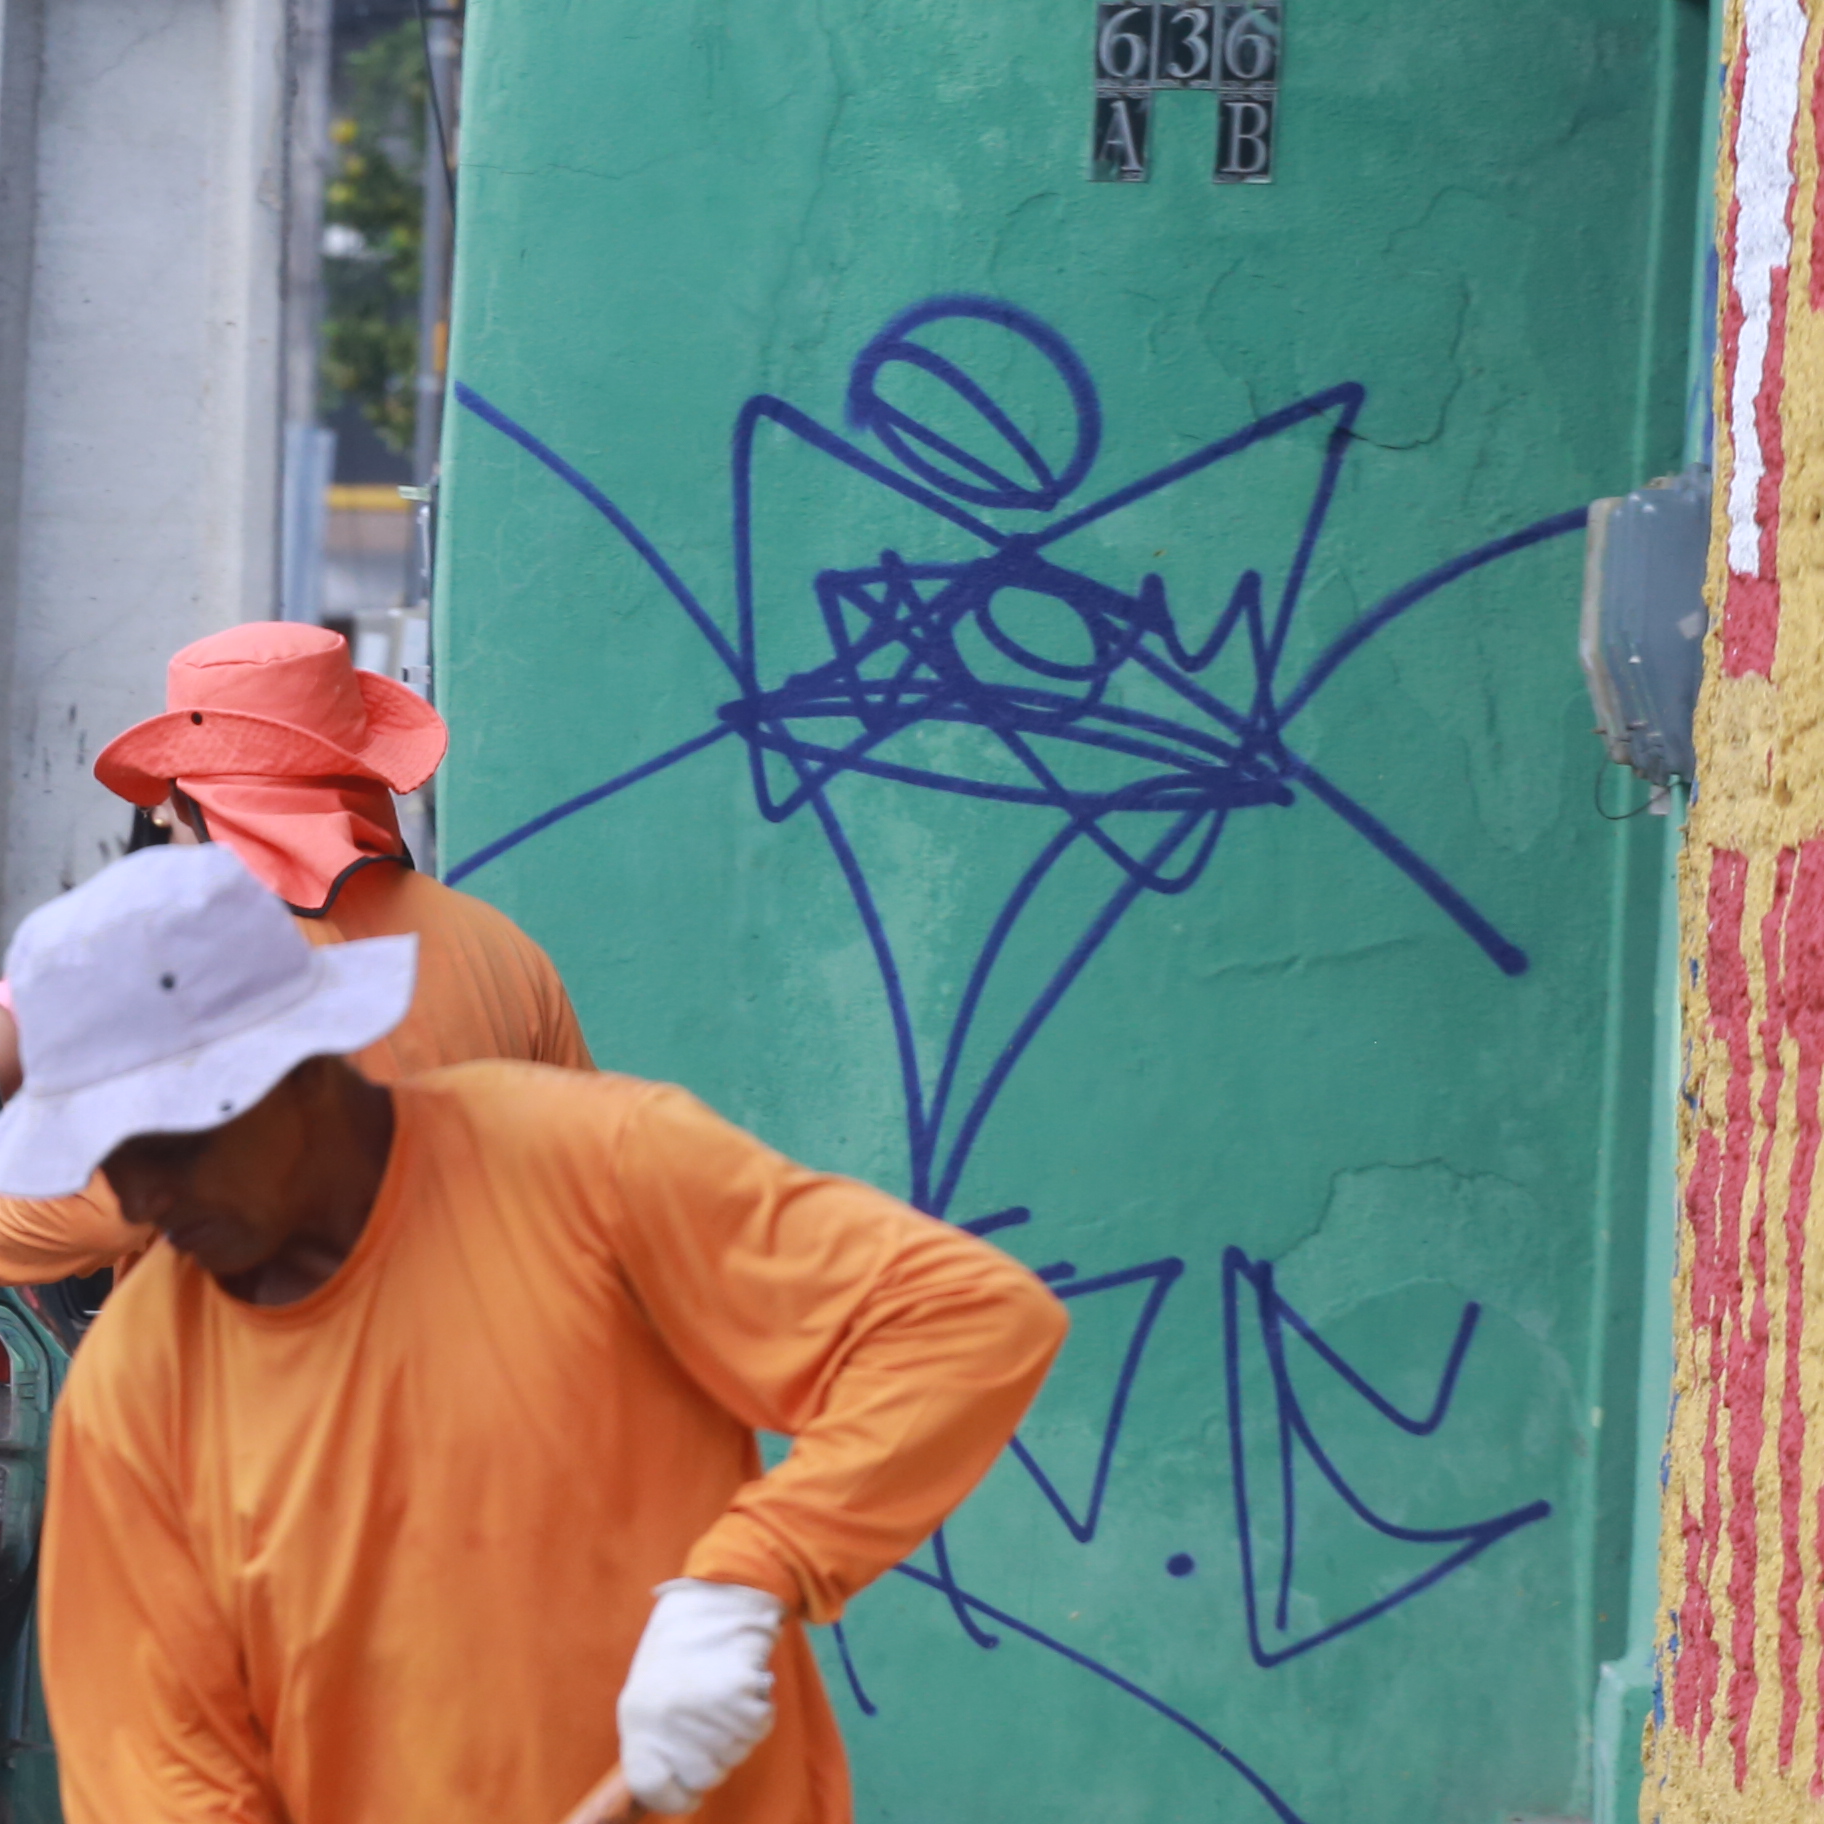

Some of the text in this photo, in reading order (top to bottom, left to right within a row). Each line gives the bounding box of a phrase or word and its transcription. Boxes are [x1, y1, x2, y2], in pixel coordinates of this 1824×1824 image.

[1098, 7, 1274, 80] 636
[1098, 100, 1269, 175] A B
